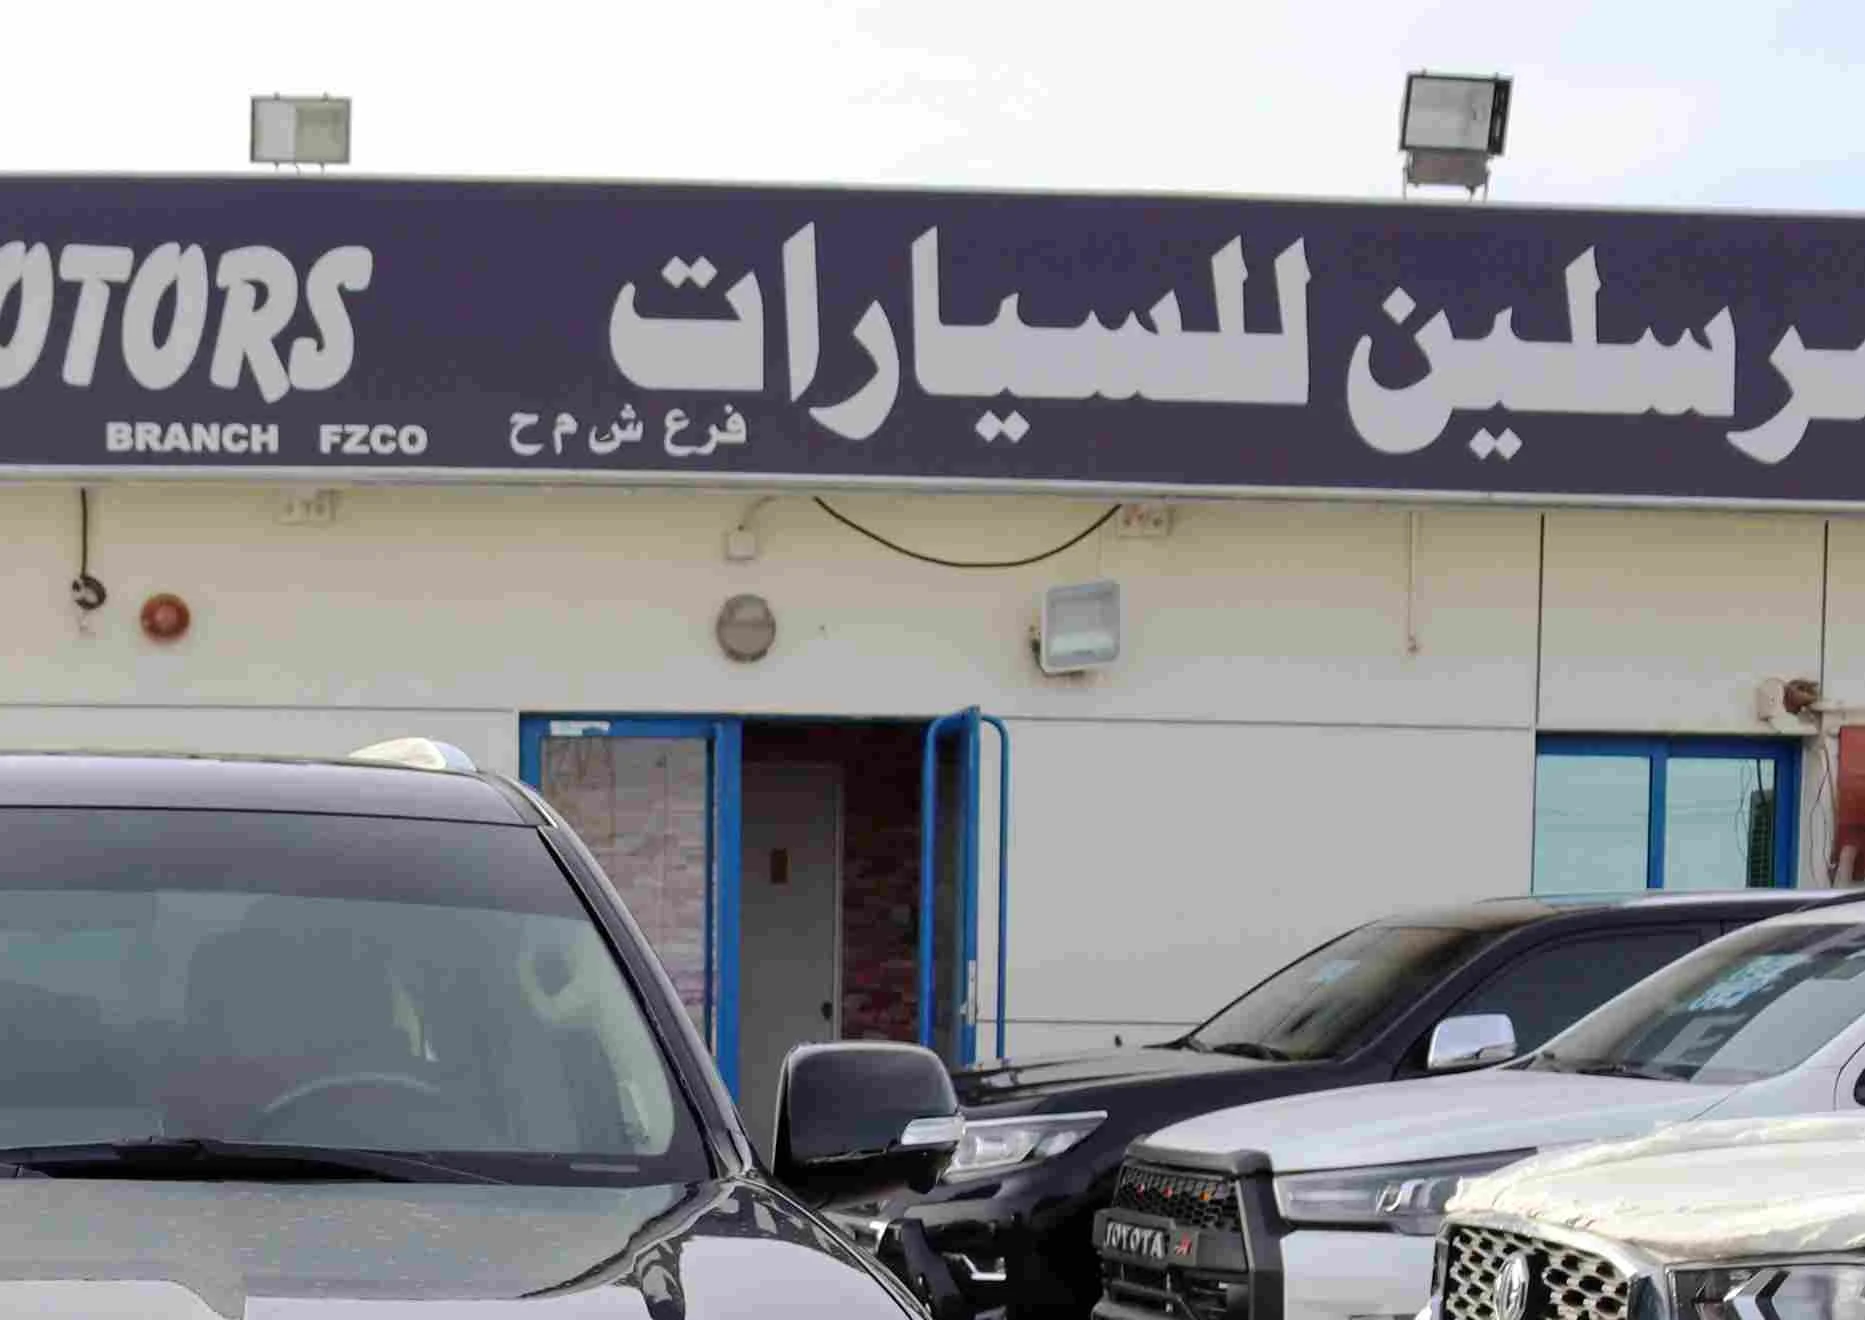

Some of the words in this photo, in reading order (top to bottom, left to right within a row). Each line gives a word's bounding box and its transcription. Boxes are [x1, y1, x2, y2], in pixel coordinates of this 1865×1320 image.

[610, 221, 1311, 444] للسيارات
[105, 421, 279, 453] BRANCH
[319, 424, 428, 454] FZCO
[663, 404, 747, 457] فرع
[1105, 1222, 1164, 1259] TOYOTA
